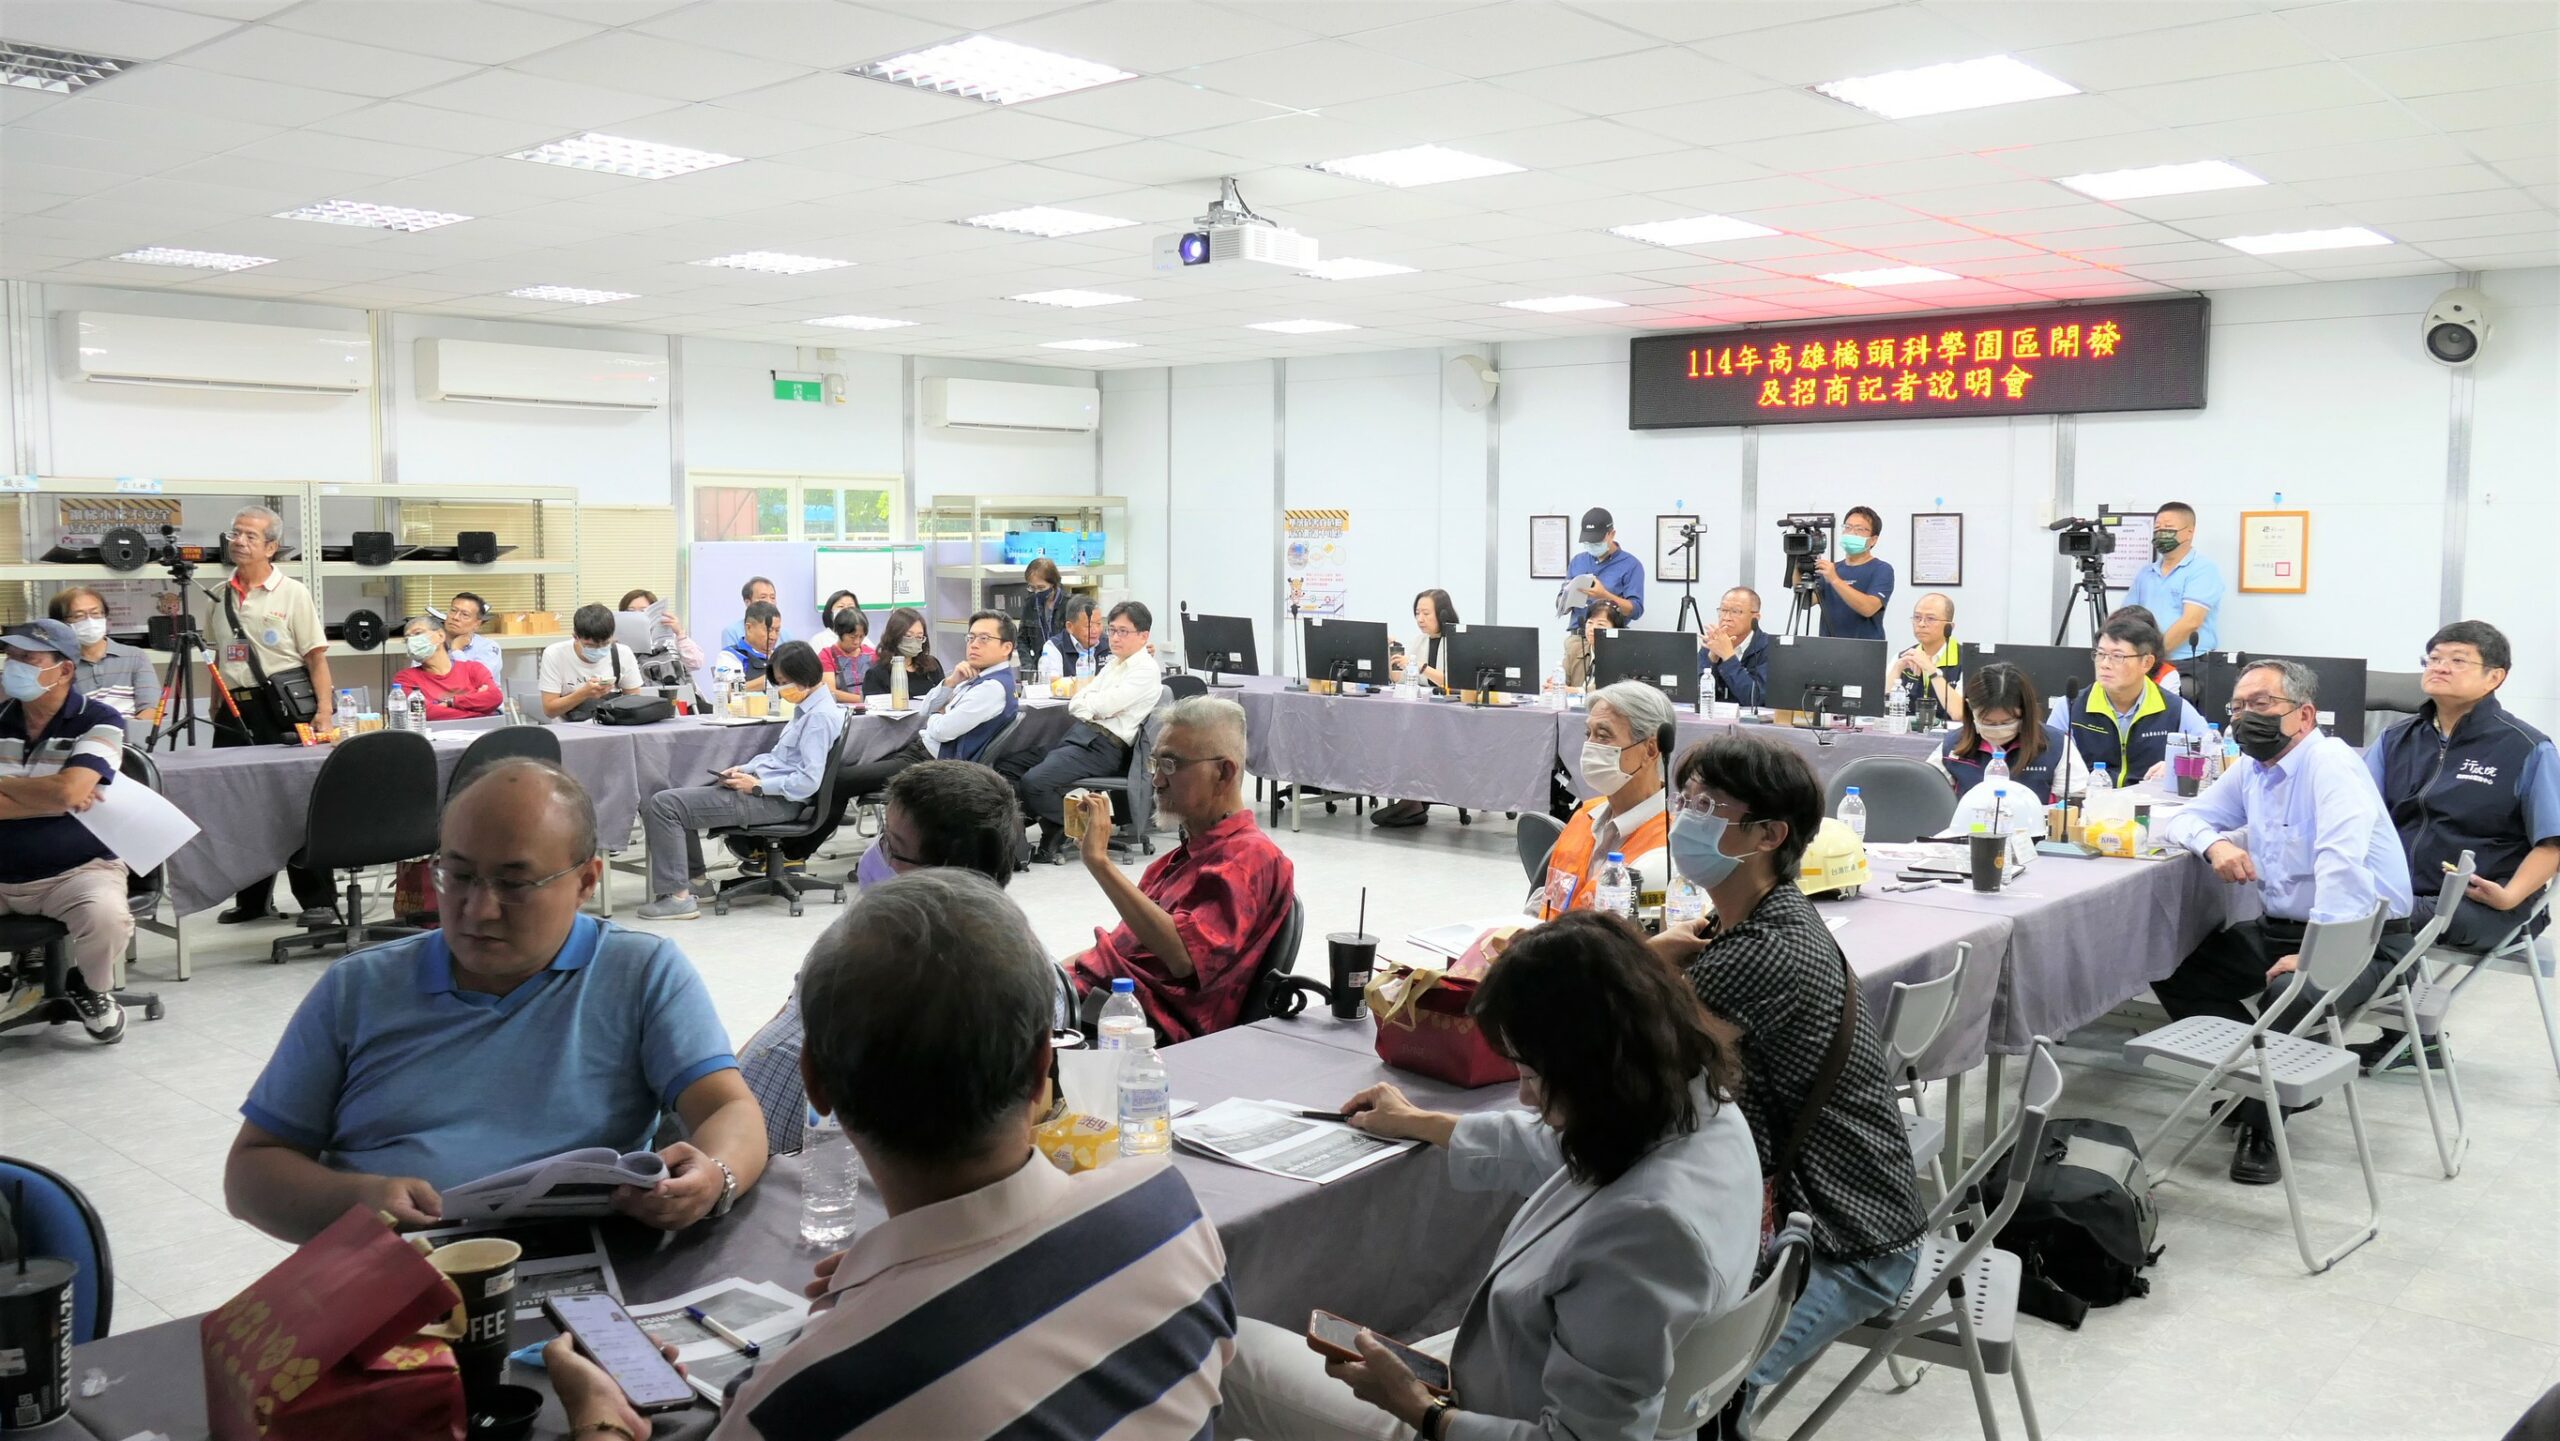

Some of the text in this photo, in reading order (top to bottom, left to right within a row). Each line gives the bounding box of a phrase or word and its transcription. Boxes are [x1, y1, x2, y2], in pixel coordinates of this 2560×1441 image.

[1687, 321, 2122, 378] 114年高雄橋頭科學園區開發
[1757, 365, 2034, 407] 及招商記者說明會
[462, 1308, 507, 1342] FEE
